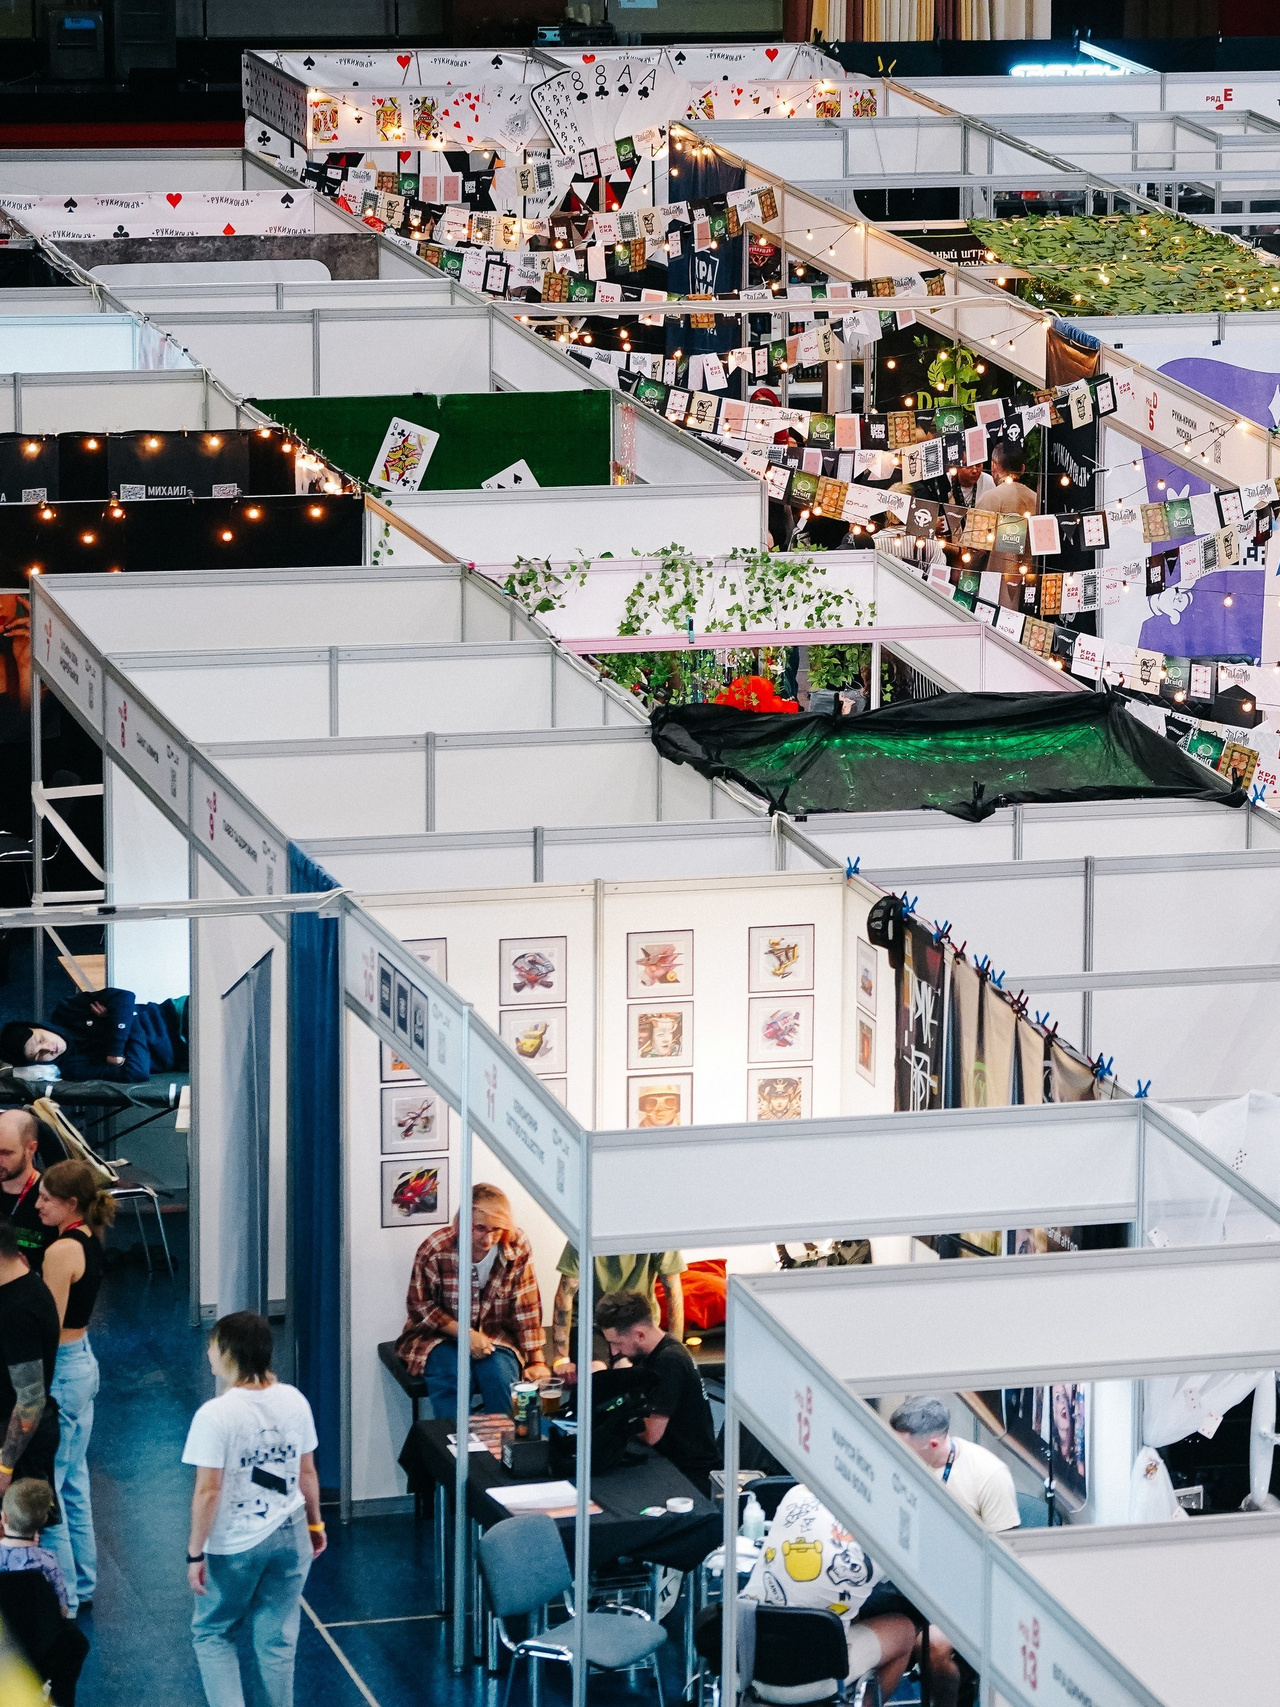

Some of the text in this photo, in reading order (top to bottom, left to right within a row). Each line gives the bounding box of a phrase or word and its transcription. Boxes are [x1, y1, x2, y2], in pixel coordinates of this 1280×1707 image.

[1205, 95, 1221, 104] РЯД
[1152, 391, 1158, 411] D
[1148, 410, 1155, 432] 5
[1176, 426, 1192, 442] МОСКВА
[147, 485, 188, 497] МИХАИЛ
[1257, 775, 1276, 786] СКА
[1258, 769, 1277, 781] КРА
[797, 1411, 811, 1454] 12
[1021, 1644, 1038, 1691] 13
